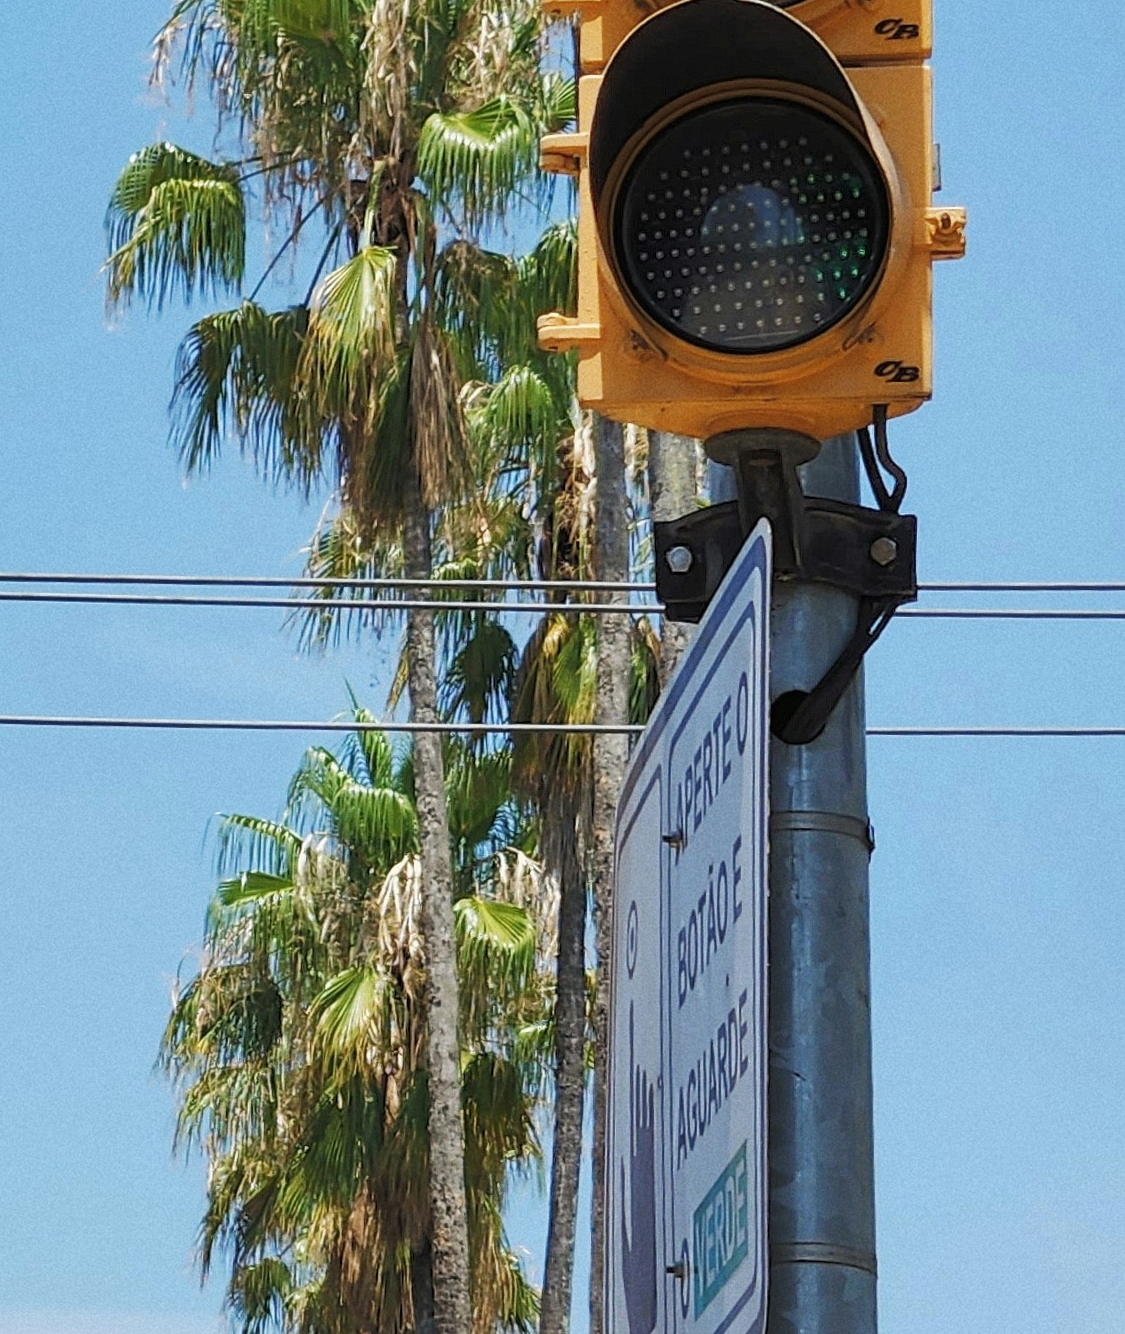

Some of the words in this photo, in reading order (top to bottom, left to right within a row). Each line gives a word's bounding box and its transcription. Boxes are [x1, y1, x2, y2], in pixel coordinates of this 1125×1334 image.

[675, 695, 732, 866] APERTE
[736, 671, 749, 757] O
[678, 860, 728, 1010] BOTÃO
[732, 833, 743, 925] E
[677, 988, 748, 1171] AGUARDE
[681, 1237, 690, 1320] O
[695, 1157, 746, 1298] VERDE
